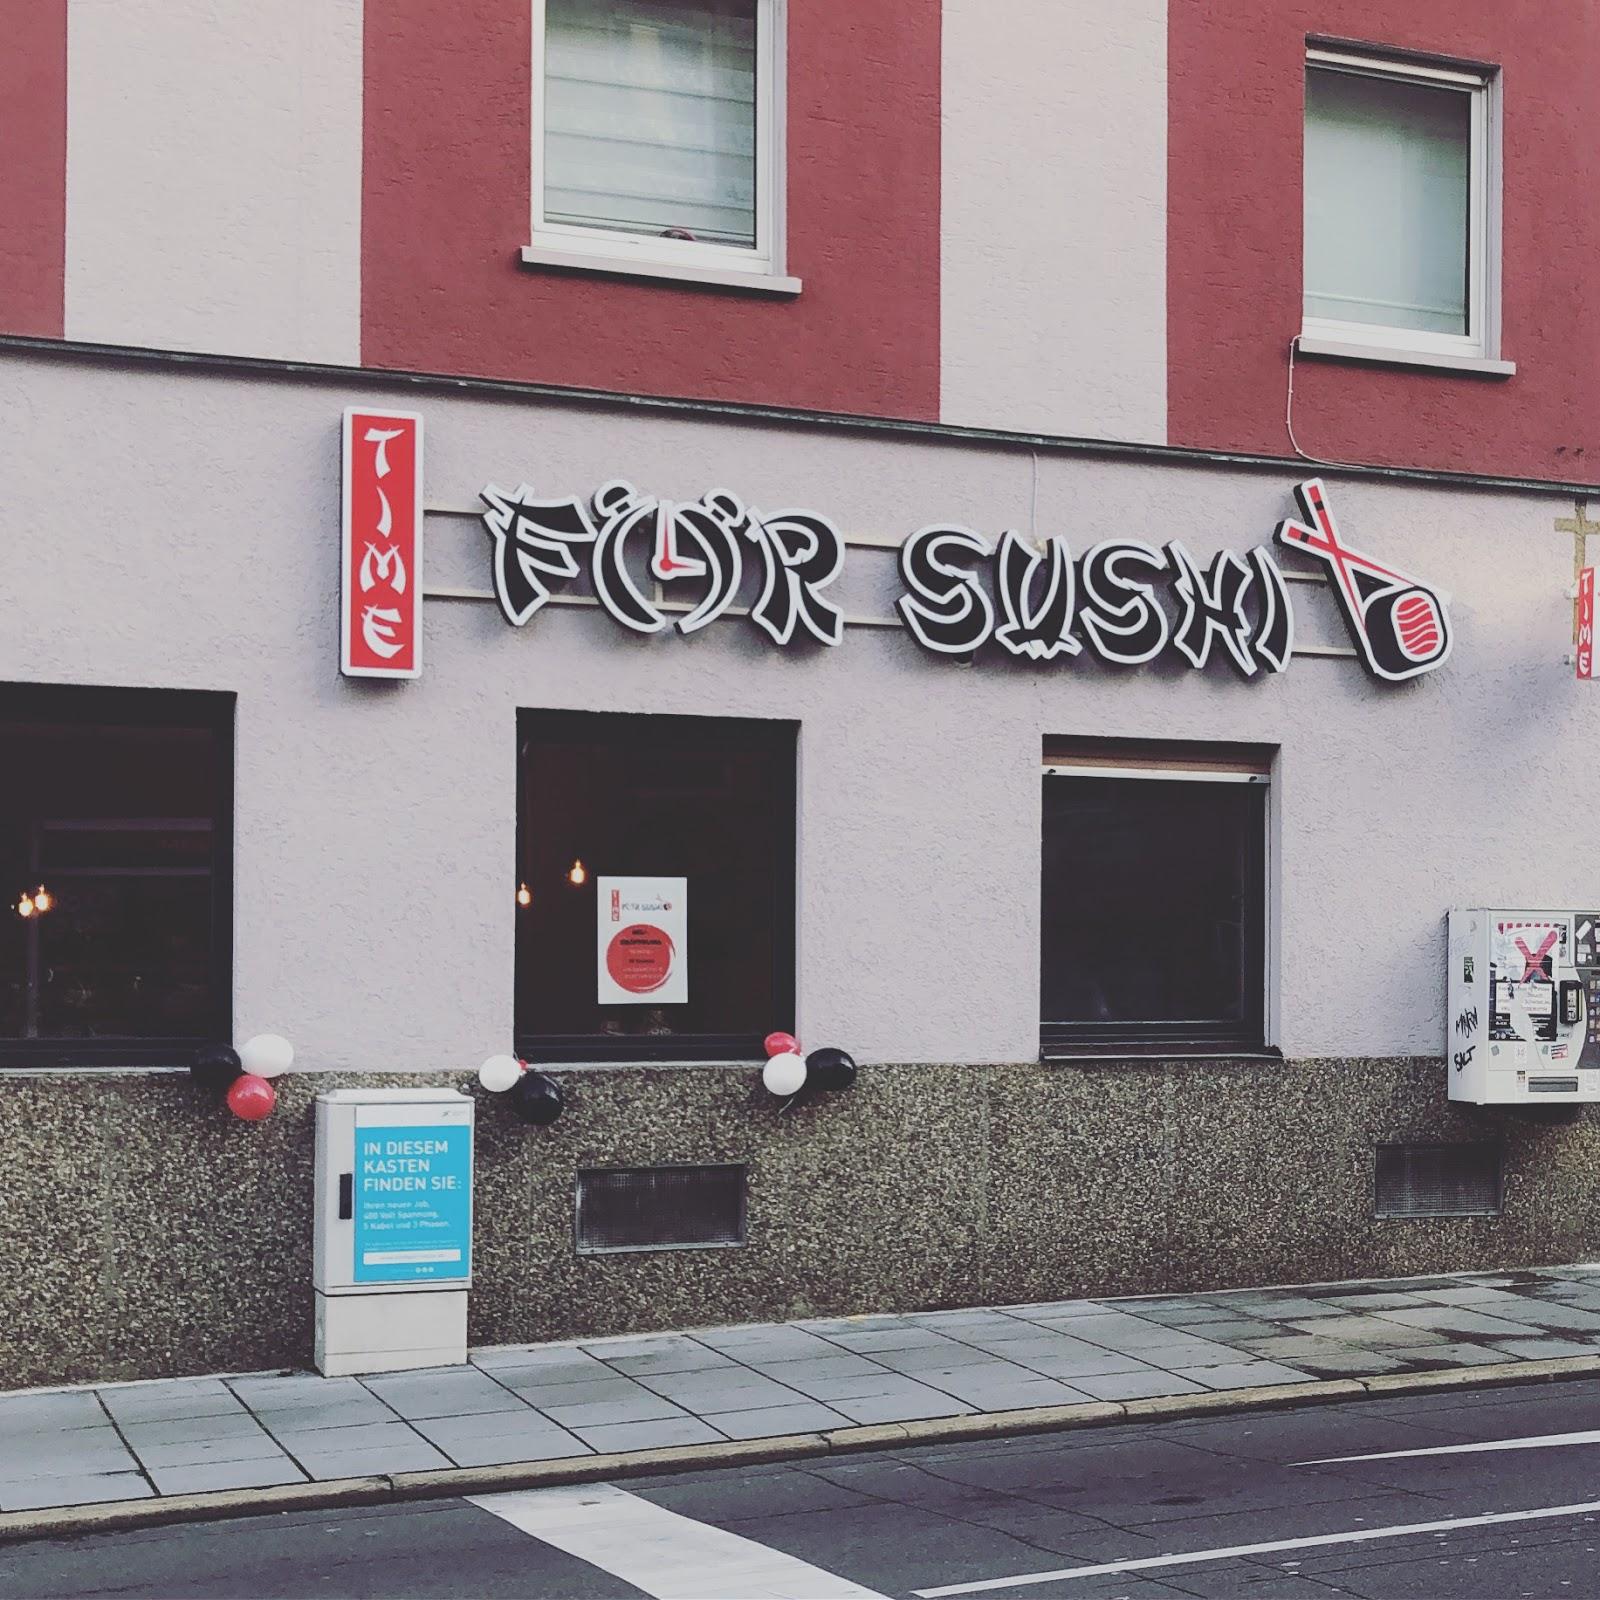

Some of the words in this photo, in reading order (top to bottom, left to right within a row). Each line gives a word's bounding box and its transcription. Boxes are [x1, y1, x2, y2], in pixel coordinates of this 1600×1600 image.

[358, 427, 407, 659] TIME
[898, 522, 1294, 677] SUSHI
[1578, 570, 1592, 675] TIME
[364, 1142, 381, 1156] IN
[386, 1140, 449, 1156] DIESEM
[364, 1159, 430, 1174] KASTEN
[364, 1177, 427, 1192] FINDEN
